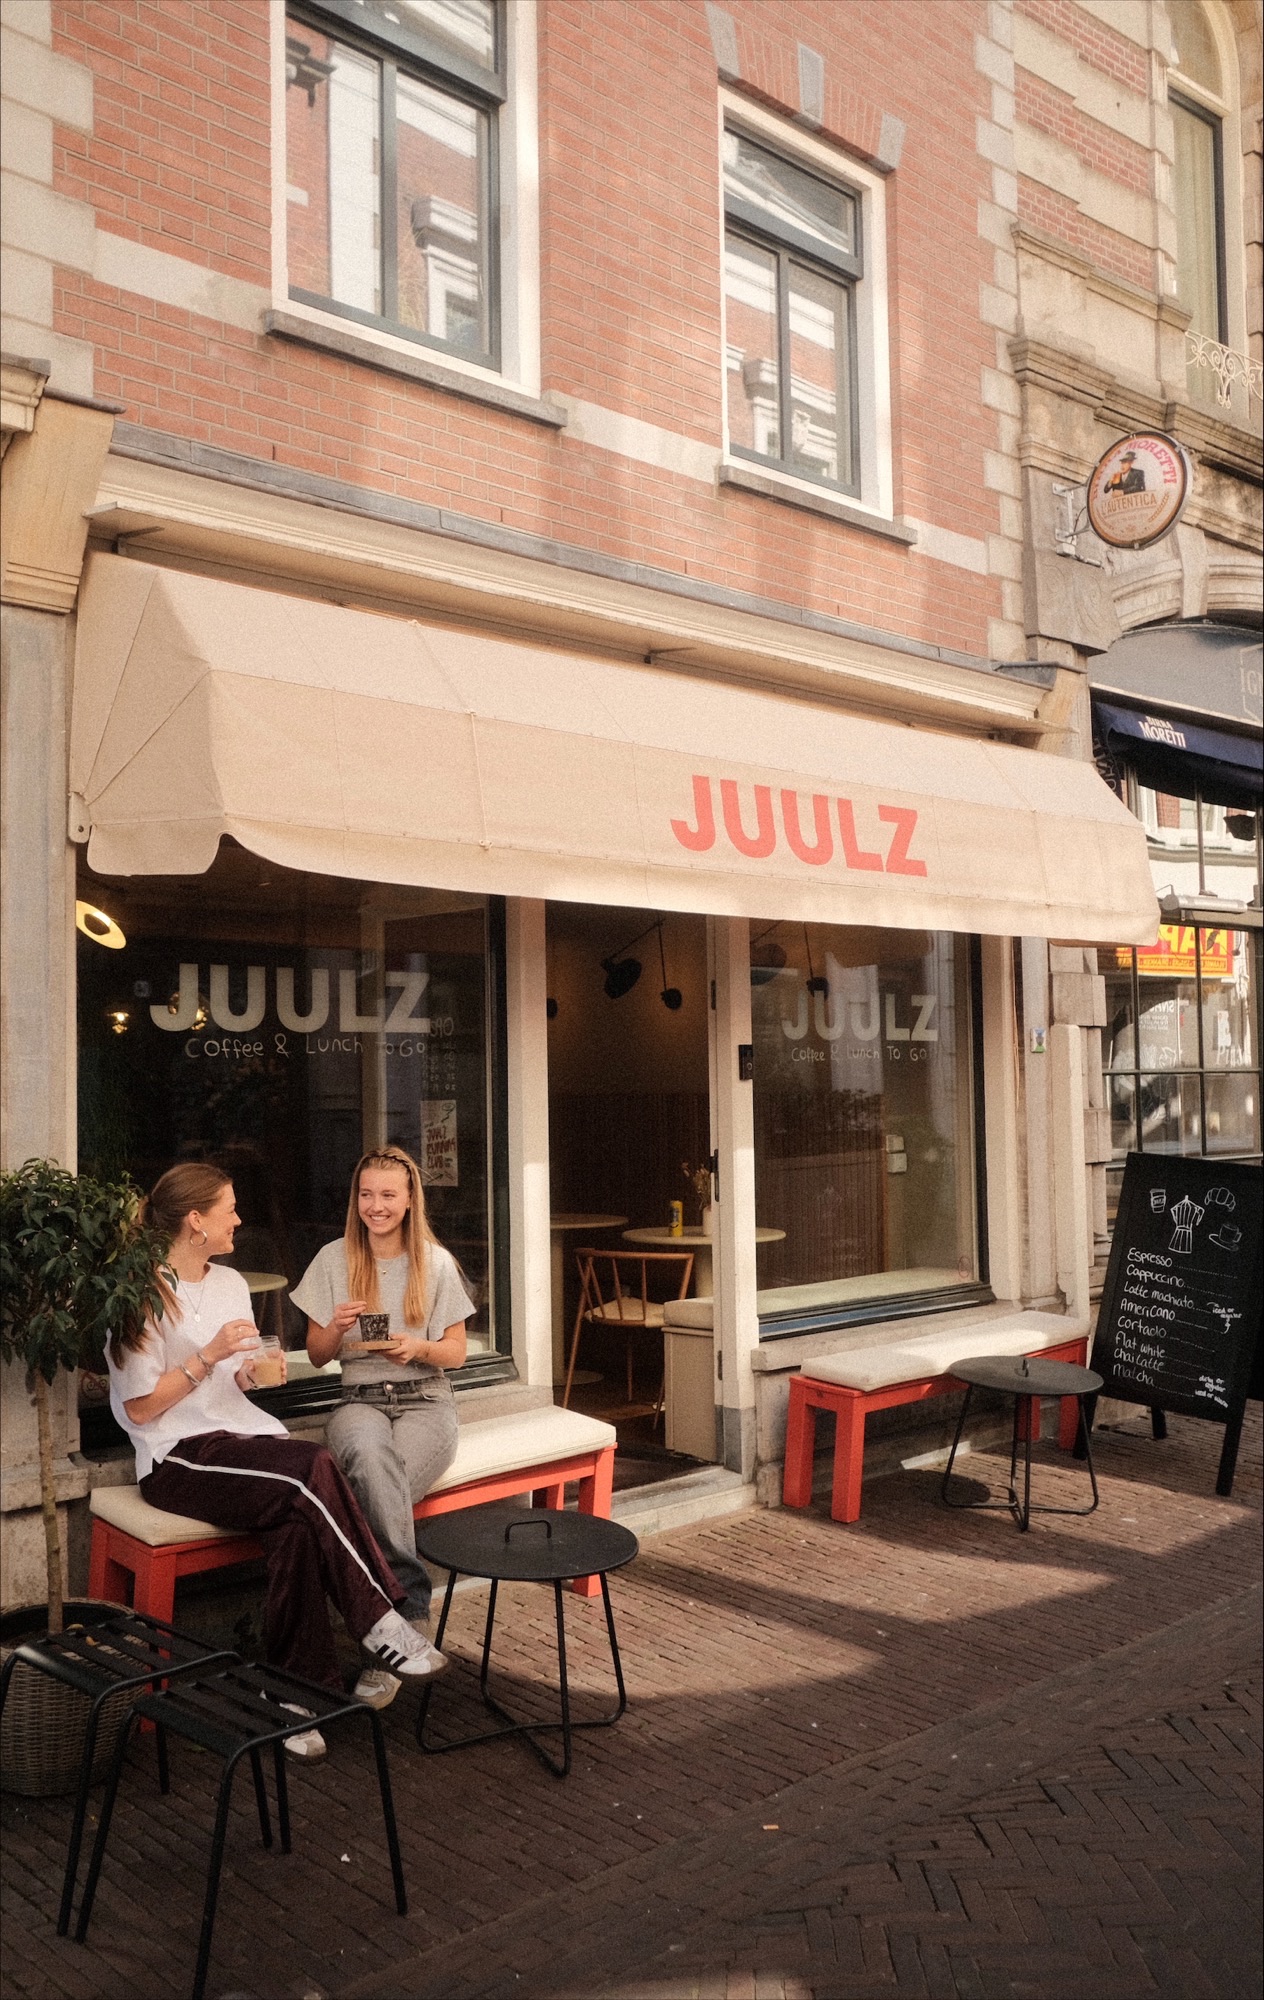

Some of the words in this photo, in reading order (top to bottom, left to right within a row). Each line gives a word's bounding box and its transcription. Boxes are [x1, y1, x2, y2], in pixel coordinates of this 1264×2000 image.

[1138, 720, 1187, 749] MORETTI
[670, 774, 928, 877] JUULZ
[150, 963, 431, 1032] JUULZ
[781, 989, 938, 1042] JUULZ
[185, 1037, 264, 1059] Coffee
[274, 1033, 289, 1058] &
[306, 1033, 363, 1054] Lunch
[399, 1039, 425, 1057] Go
[791, 1047, 826, 1062] Coffee
[846, 1044, 880, 1060] Lunch
[1127, 1247, 1173, 1268] Espresso
[1126, 1264, 1185, 1288] Cappuccino
[1123, 1281, 1149, 1298] Latte
[1117, 1315, 1167, 1338] Cortado
[1115, 1330, 1137, 1350] Flat
[1140, 1343, 1166, 1358] white
